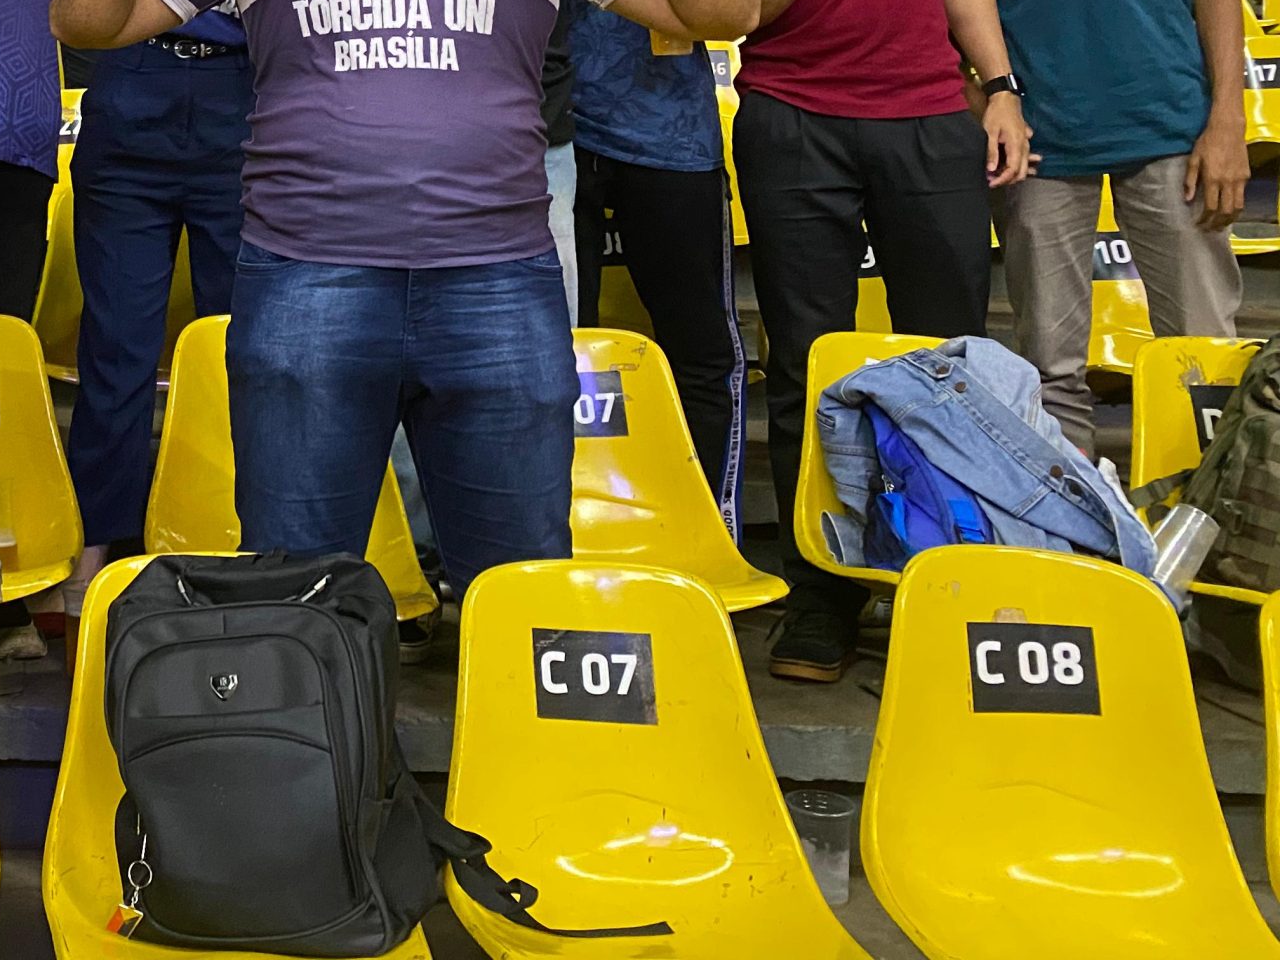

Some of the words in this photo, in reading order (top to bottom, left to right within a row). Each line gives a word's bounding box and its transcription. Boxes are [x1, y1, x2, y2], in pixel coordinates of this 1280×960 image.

[334, 31, 460, 72] BRASÍLIA
[1094, 239, 1132, 264] 10
[574, 393, 615, 424] 07
[540, 651, 568, 694] C
[581, 652, 638, 695] 07
[975, 640, 1005, 685] C
[1018, 641, 1084, 685] 08
